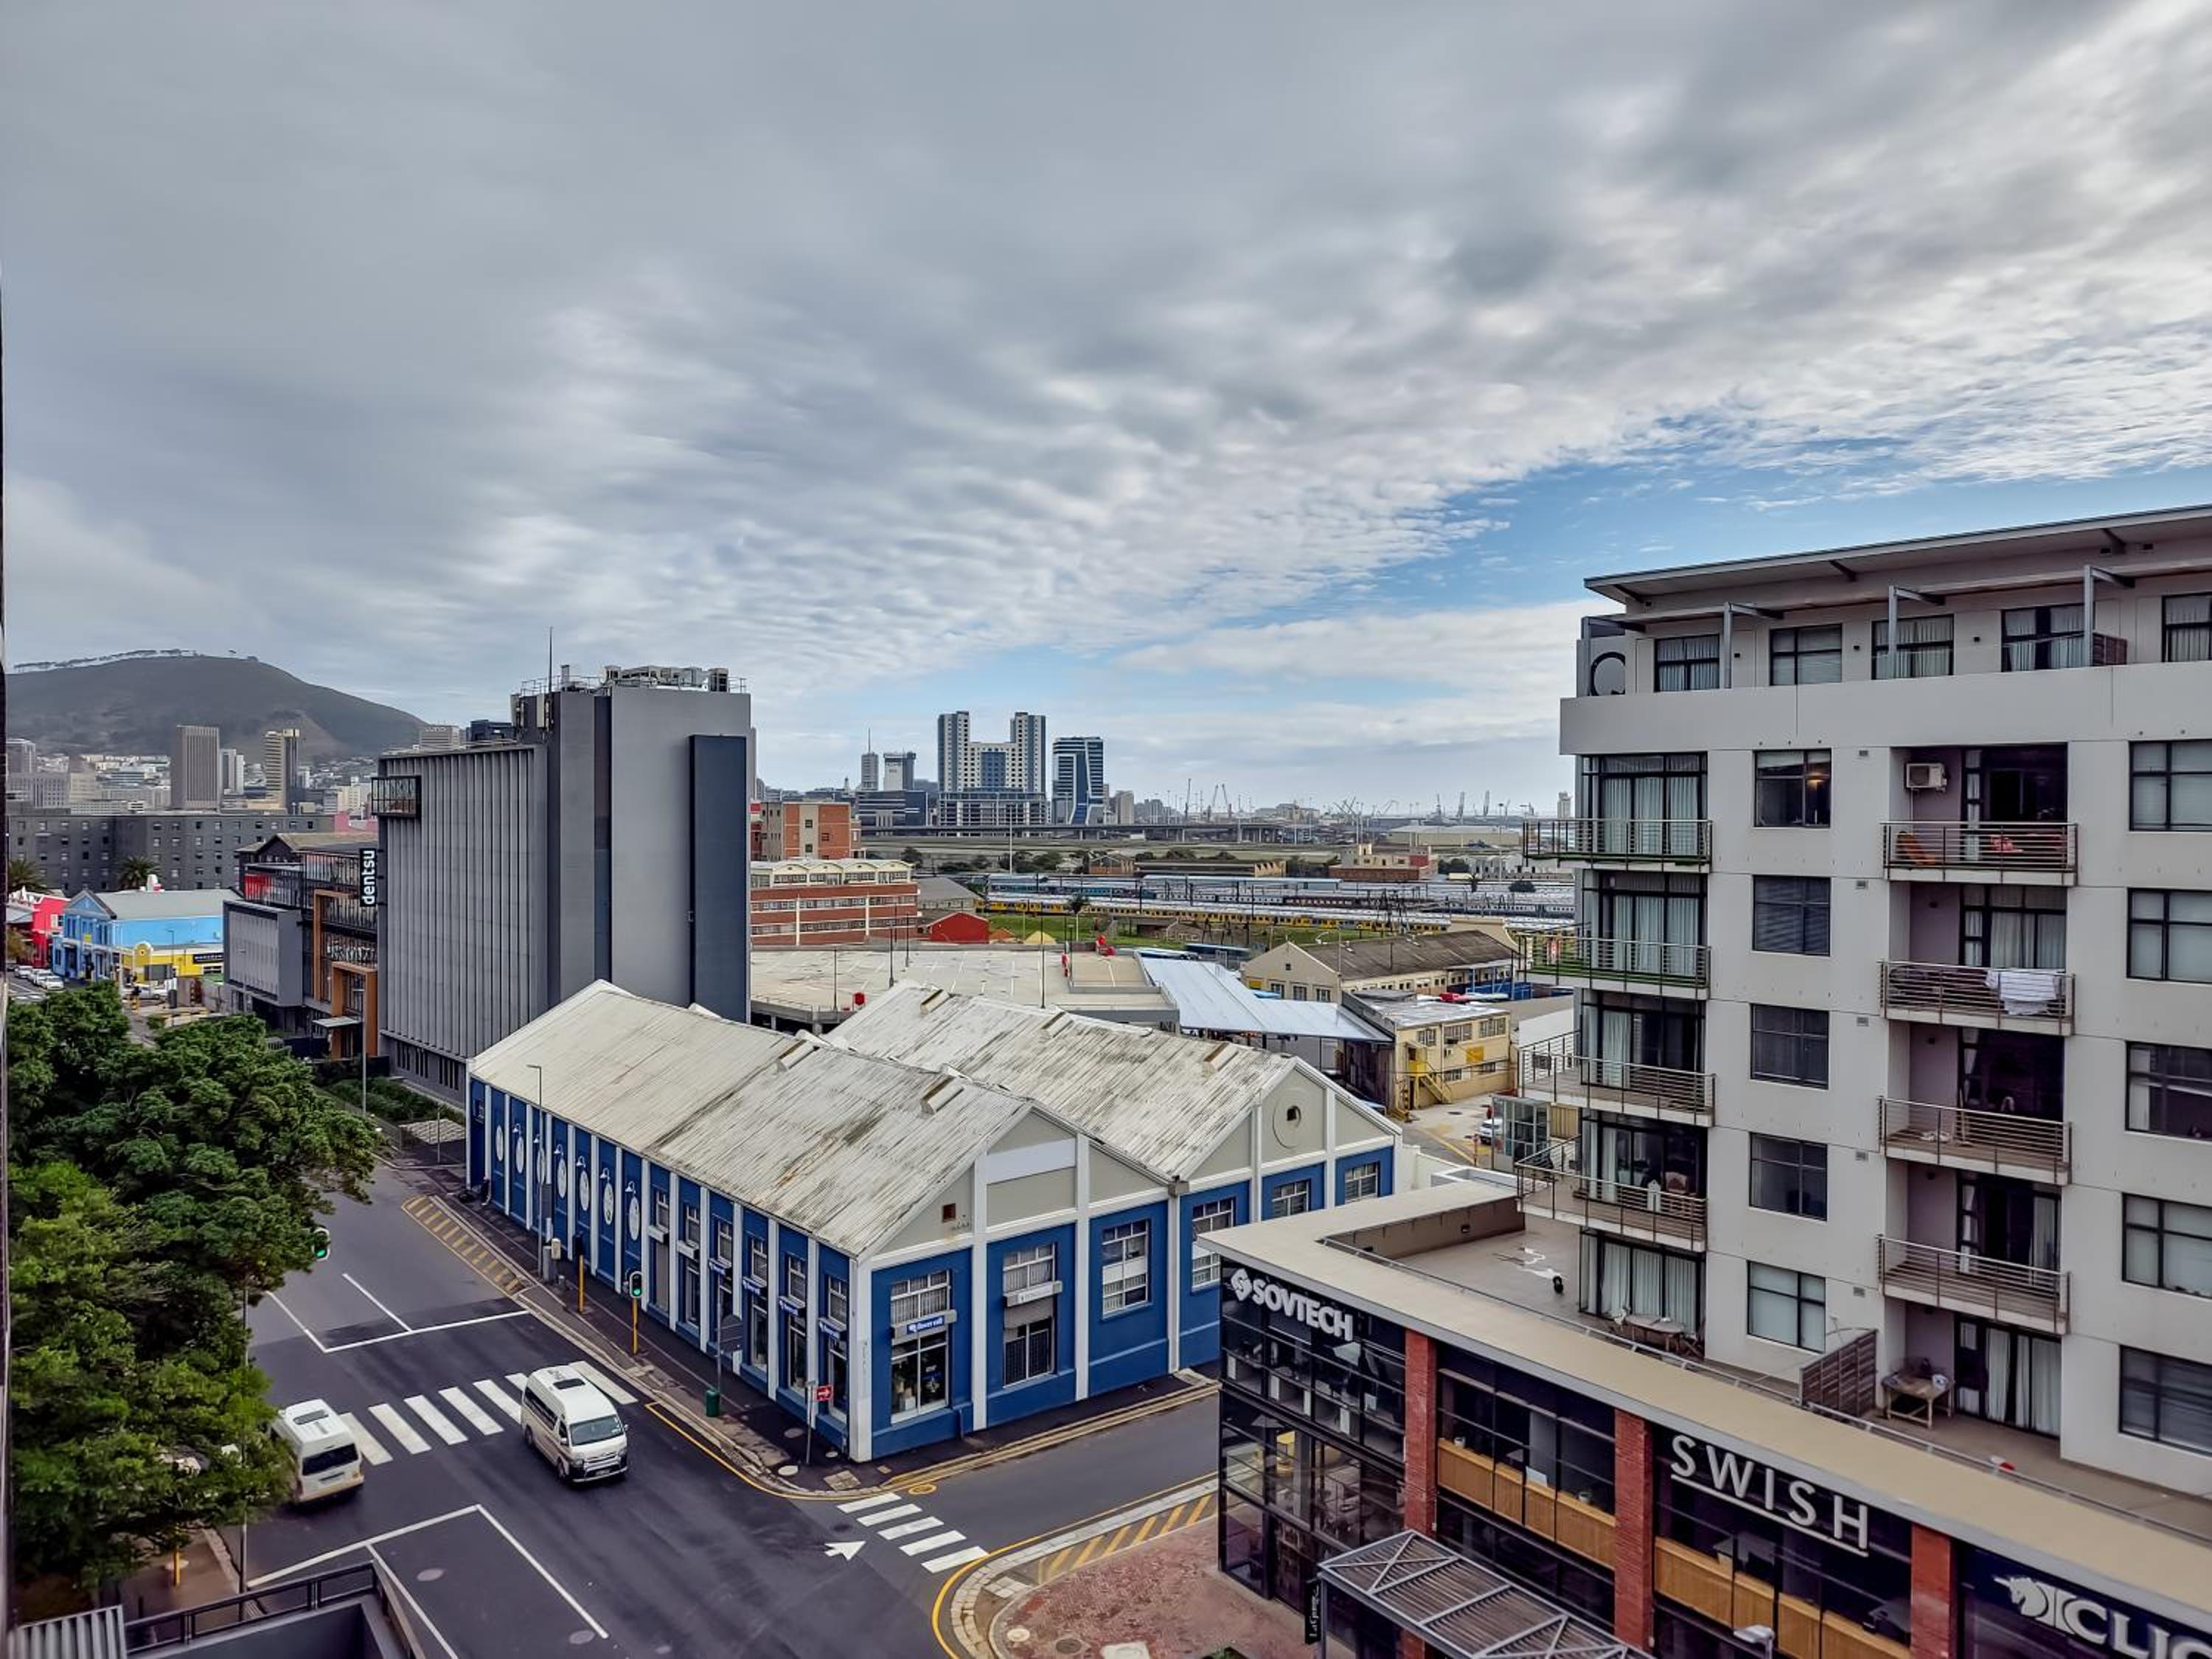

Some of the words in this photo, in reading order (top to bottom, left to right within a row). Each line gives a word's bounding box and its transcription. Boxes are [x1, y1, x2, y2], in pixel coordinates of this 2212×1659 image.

[361, 850, 375, 905] dentsu
[1252, 1279, 1353, 1341] SOVTECH
[1671, 1435, 1868, 1549] SWISH
